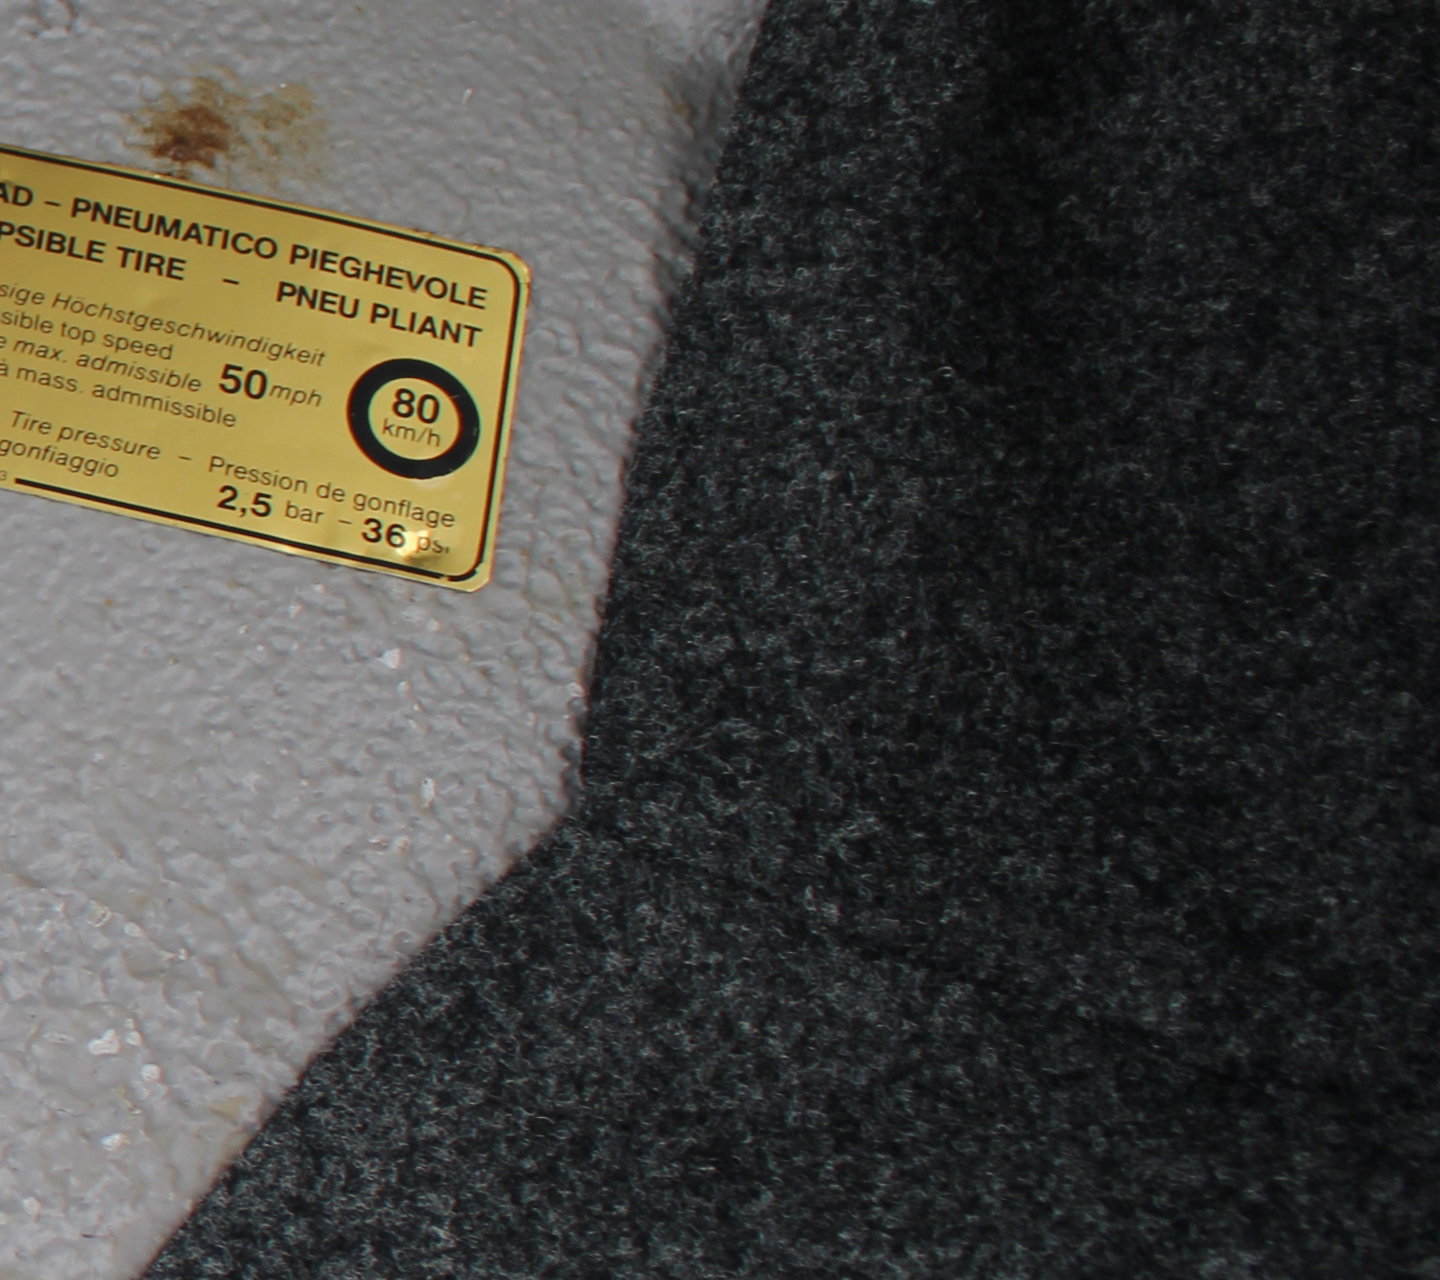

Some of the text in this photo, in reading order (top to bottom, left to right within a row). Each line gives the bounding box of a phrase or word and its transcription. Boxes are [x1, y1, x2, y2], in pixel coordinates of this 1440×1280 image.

[70, 197, 278, 260] PNEUMATICO
[289, 243, 488, 310] PIEGHEVOLE
[116, 245, 187, 281] TIRE
[276, 281, 360, 319] PNEU
[369, 302, 483, 348] PLIANT
[51, 292, 326, 367] Höchstgeschwindigkeit
[60, 321, 96, 346] top
[102, 333, 174, 361] speed
[12, 340, 67, 363] max.
[75, 353, 202, 393] admissible
[218, 363, 322, 407] 50 mph
[16, 367, 82, 394] mass.
[91, 384, 237, 428] admmissible
[391, 387, 441, 425] 80
[382, 418, 441, 448] km/h
[12, 410, 52, 436] Tire
[56, 426, 161, 460] pressure
[208, 455, 308, 494] Pression
[315, 482, 346, 503] de
[353, 493, 456, 529] gonflage
[216, 484, 273, 518] 2,5
[284, 500, 325, 524] bar
[361, 517, 406, 548] 36
